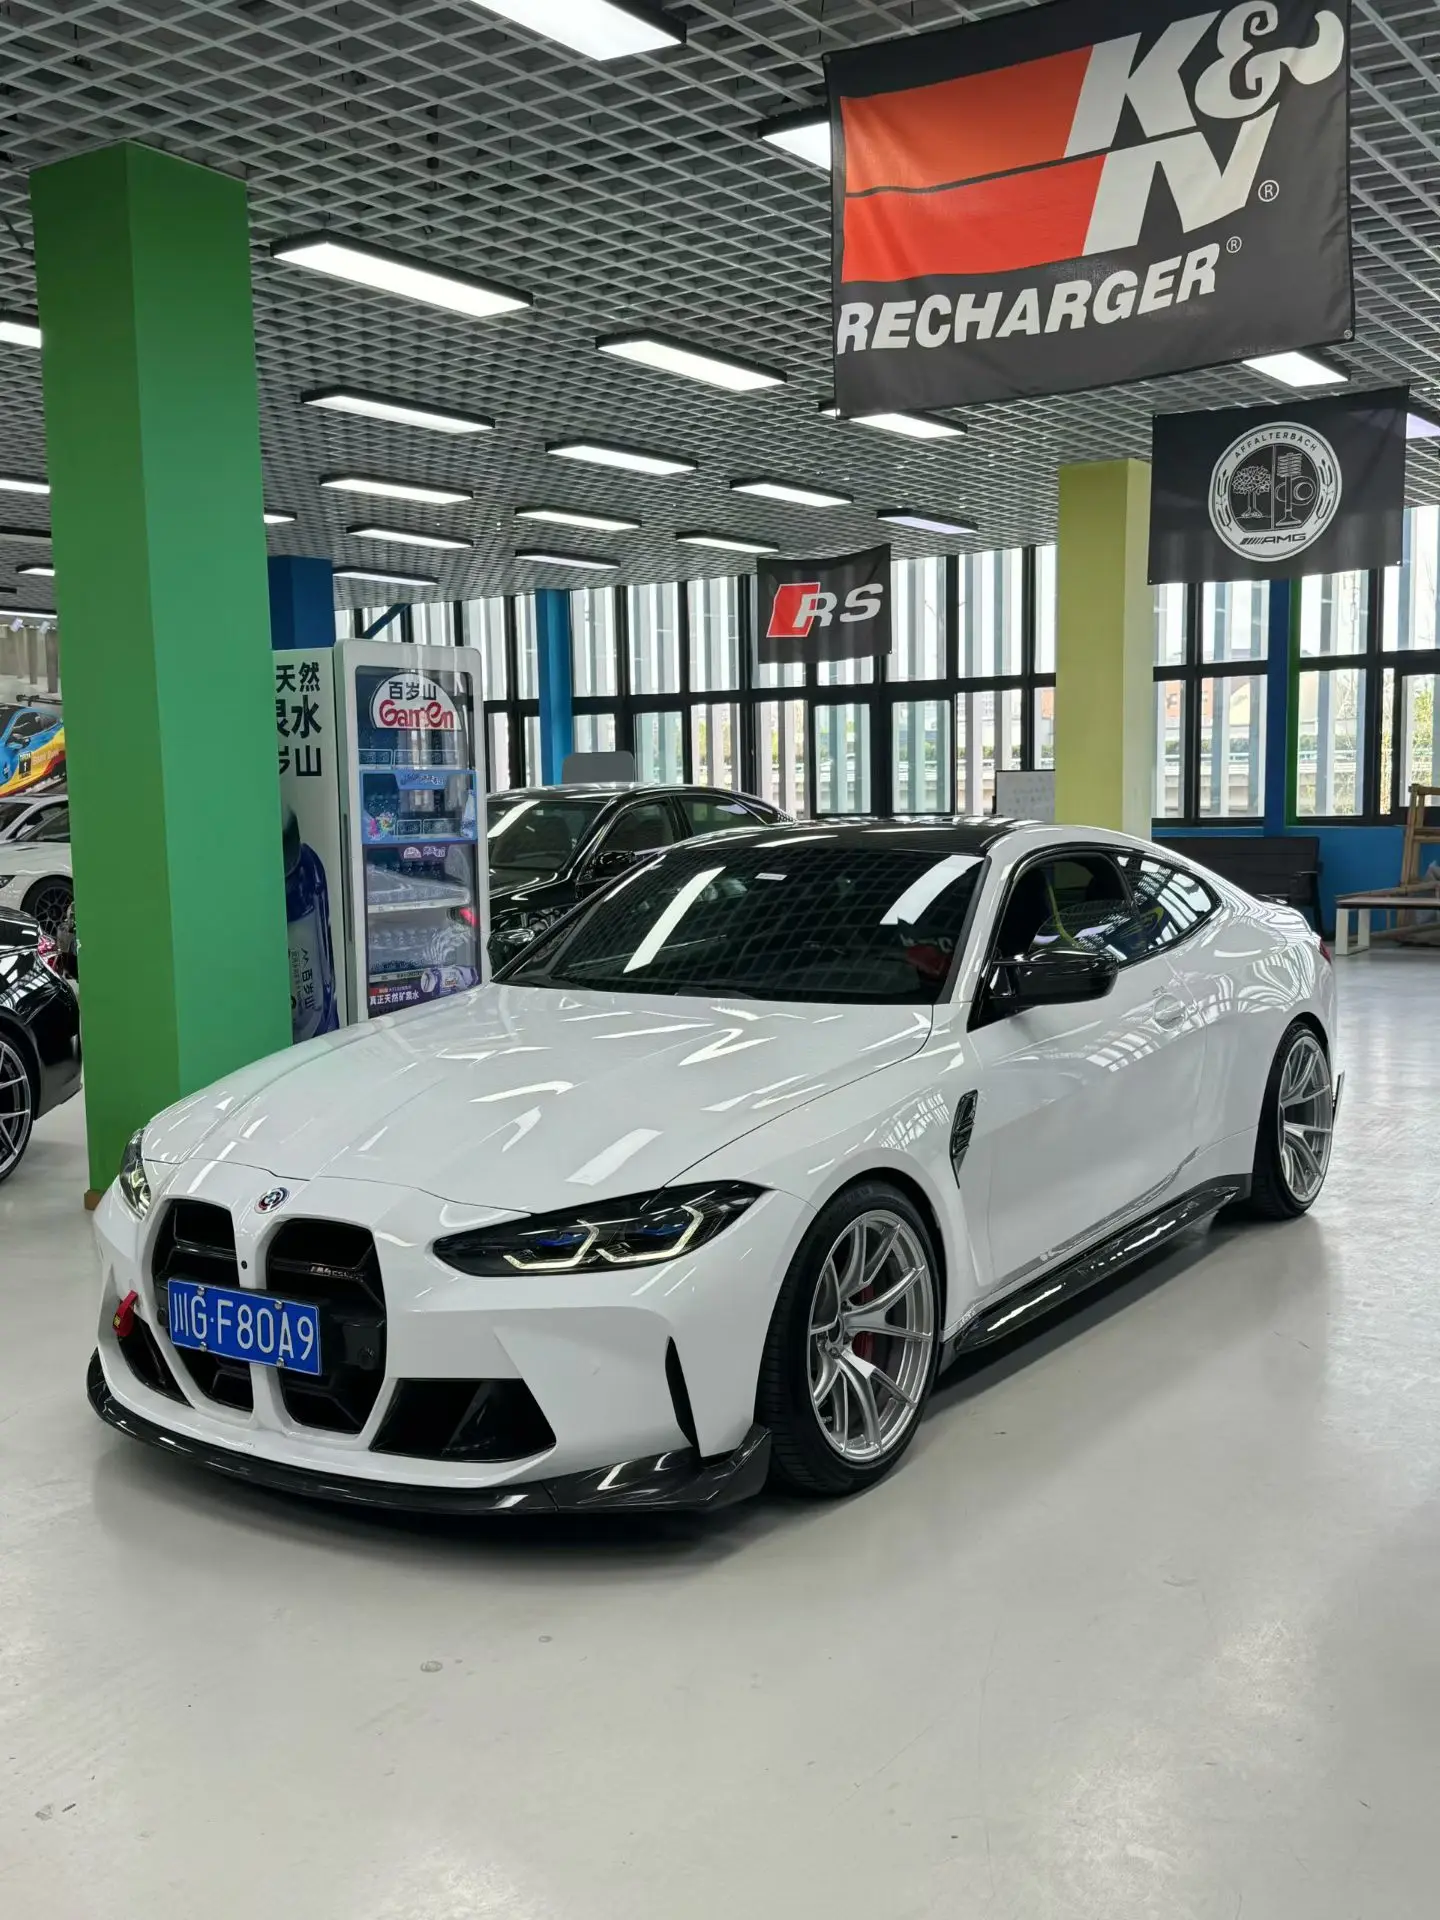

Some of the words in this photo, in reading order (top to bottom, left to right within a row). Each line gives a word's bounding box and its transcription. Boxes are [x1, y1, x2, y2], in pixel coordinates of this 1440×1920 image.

[837, 243, 1220, 355] RECHARGER
[1234, 432, 1317, 459] AFFALTERBACH
[792, 583, 884, 628] RS
[276, 662, 321, 693] 天然
[388, 681, 437, 701] 百岁山
[173, 1292, 314, 1361] 川G·F80A9
